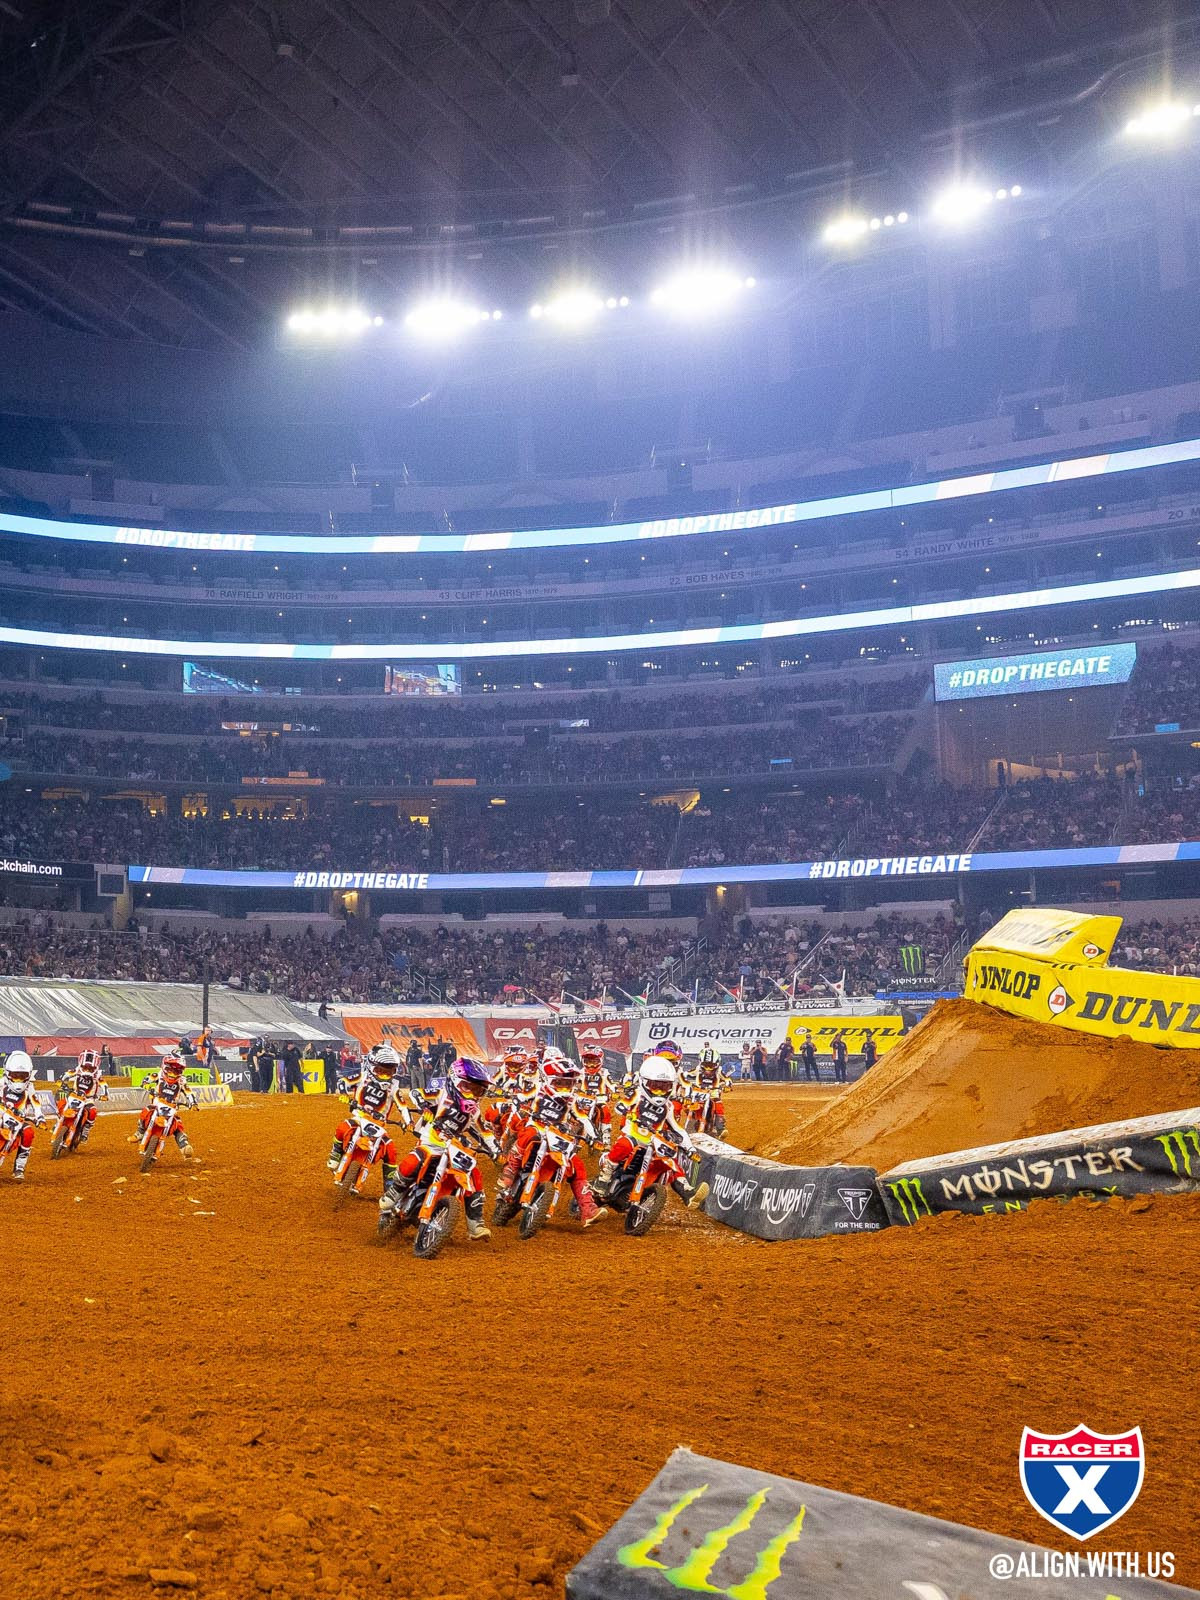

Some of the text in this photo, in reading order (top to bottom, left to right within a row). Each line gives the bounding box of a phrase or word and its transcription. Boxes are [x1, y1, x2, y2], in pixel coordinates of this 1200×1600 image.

[639, 505, 797, 538] #DROPTHEGATE
[115, 527, 256, 551] #DROPTHEGATE
[914, 543, 952, 556] RANDY
[956, 537, 993, 549] WHITE
[686, 574, 708, 583] BOB
[711, 571, 745, 582] HAYES
[219, 590, 264, 600] RAYFIELD
[267, 591, 304, 600] WRIGHT
[455, 590, 482, 600] CLIFF
[486, 588, 522, 598] HARRIS
[949, 656, 1112, 688] #DROPTHEGATE
[808, 854, 972, 879] #DROPTHEGATE
[293, 872, 429, 890] #DROPTHEGATE
[381, 1022, 435, 1038] KTM
[672, 1026, 773, 1040] Husqvarna
[366, 1085, 384, 1098] TLD
[643, 1101, 665, 1114] TLD
[939, 1146, 1145, 1201] MONSTER
[834, 1221, 849, 1229] FOR
